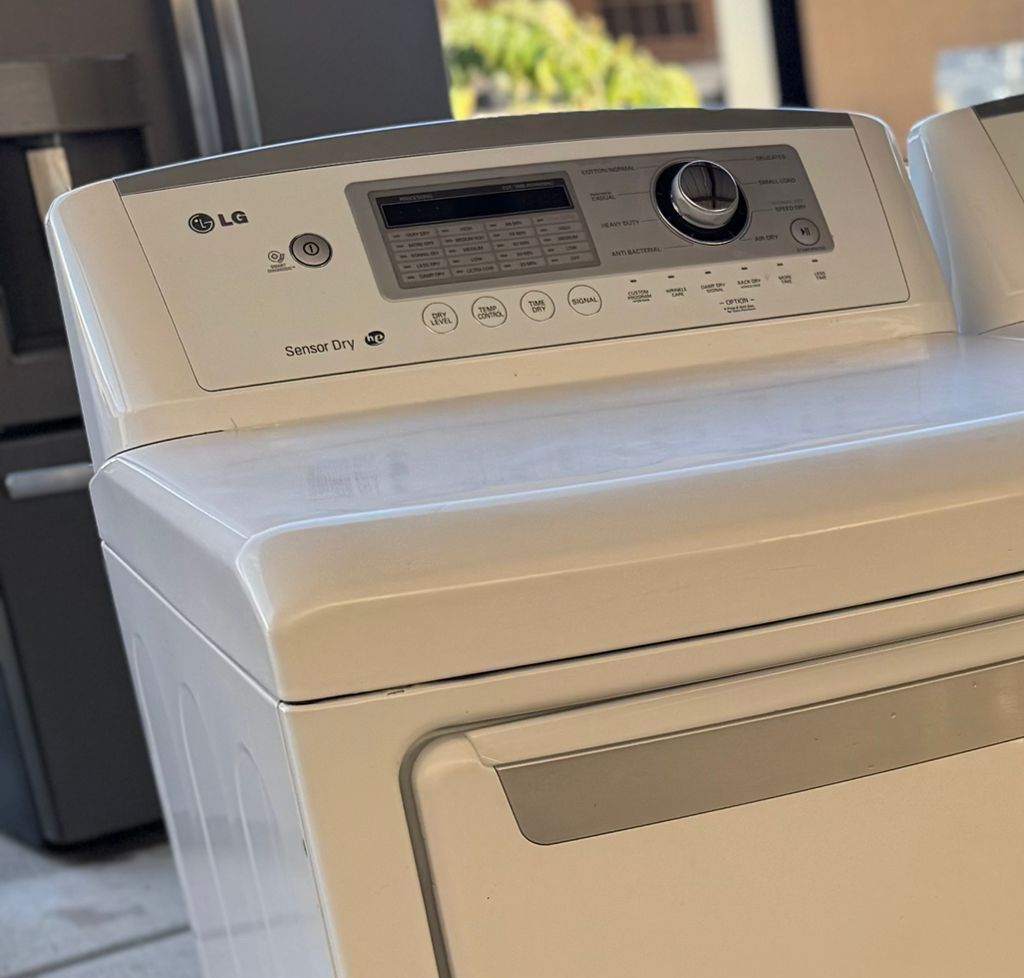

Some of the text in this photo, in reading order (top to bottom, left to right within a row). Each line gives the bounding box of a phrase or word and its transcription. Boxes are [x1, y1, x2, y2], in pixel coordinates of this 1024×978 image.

[217, 210, 249, 227] LG
[528, 299, 546, 307] TIME
[571, 296, 598, 306] SIGNAL
[478, 304, 498, 313] TEMP
[431, 312, 447, 320] DRY
[477, 311, 505, 320] CONTROL
[430, 318, 453, 326] LEVEL
[285, 338, 355, 357] Sensor Dry
